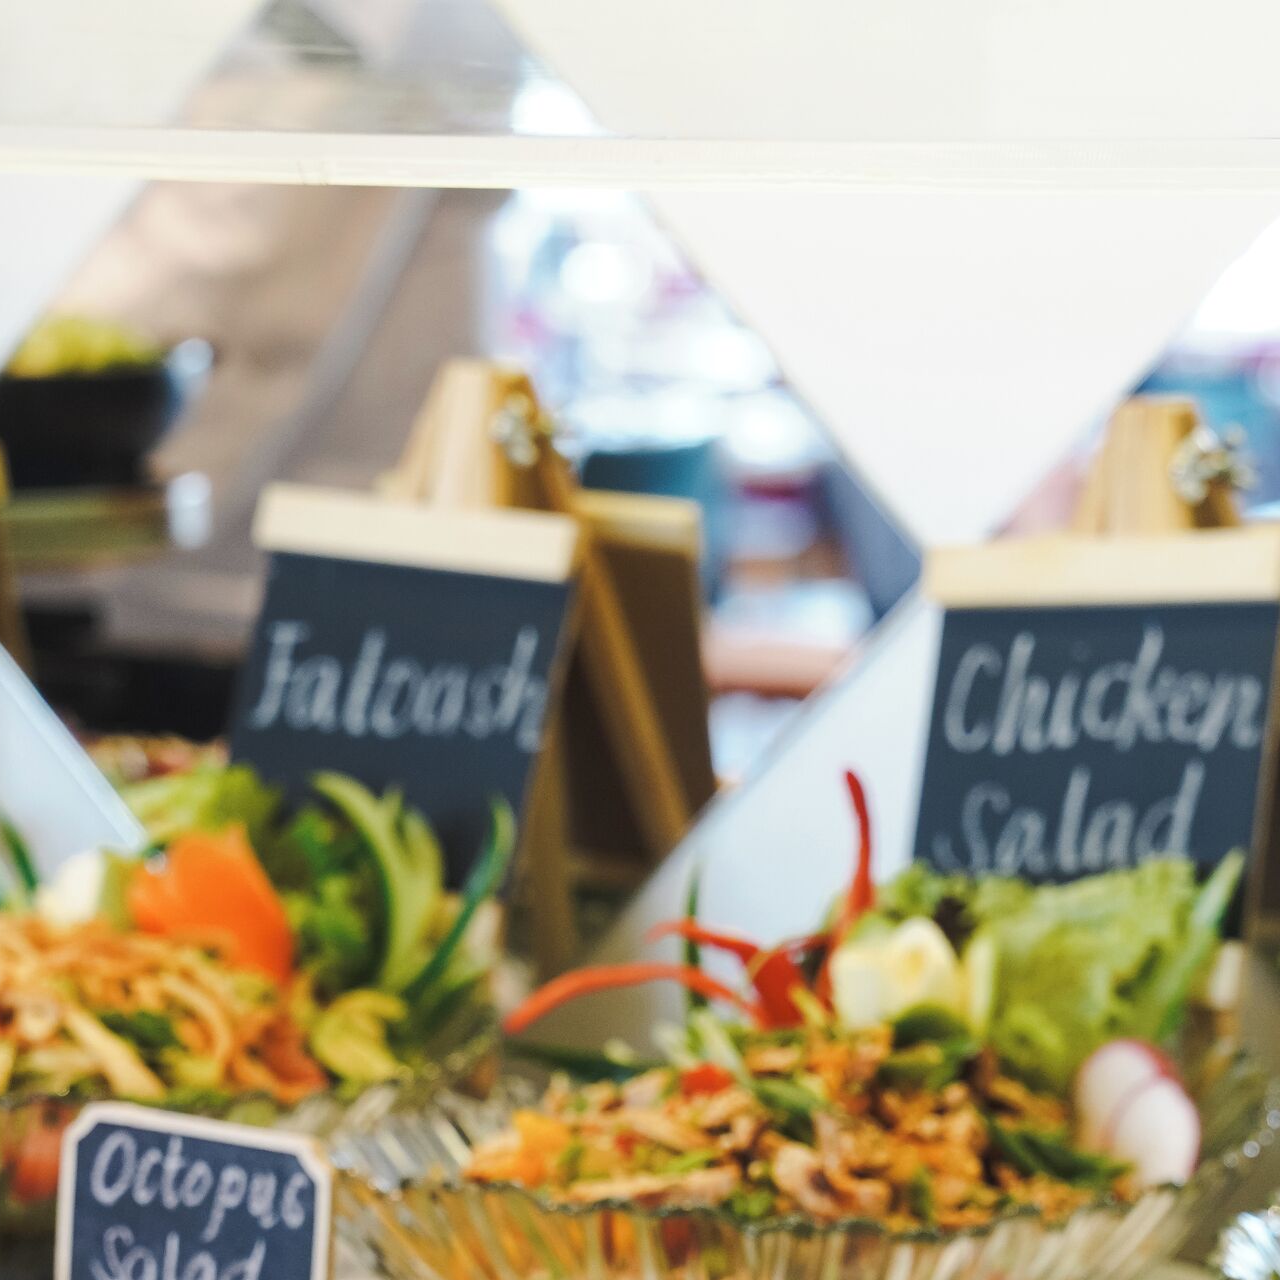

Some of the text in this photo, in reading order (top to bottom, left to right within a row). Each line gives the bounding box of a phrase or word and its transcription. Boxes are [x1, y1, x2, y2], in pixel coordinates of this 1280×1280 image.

[944, 624, 1266, 757] Chicken
[931, 759, 1206, 877] Salad
[90, 1130, 310, 1242] Octopus
